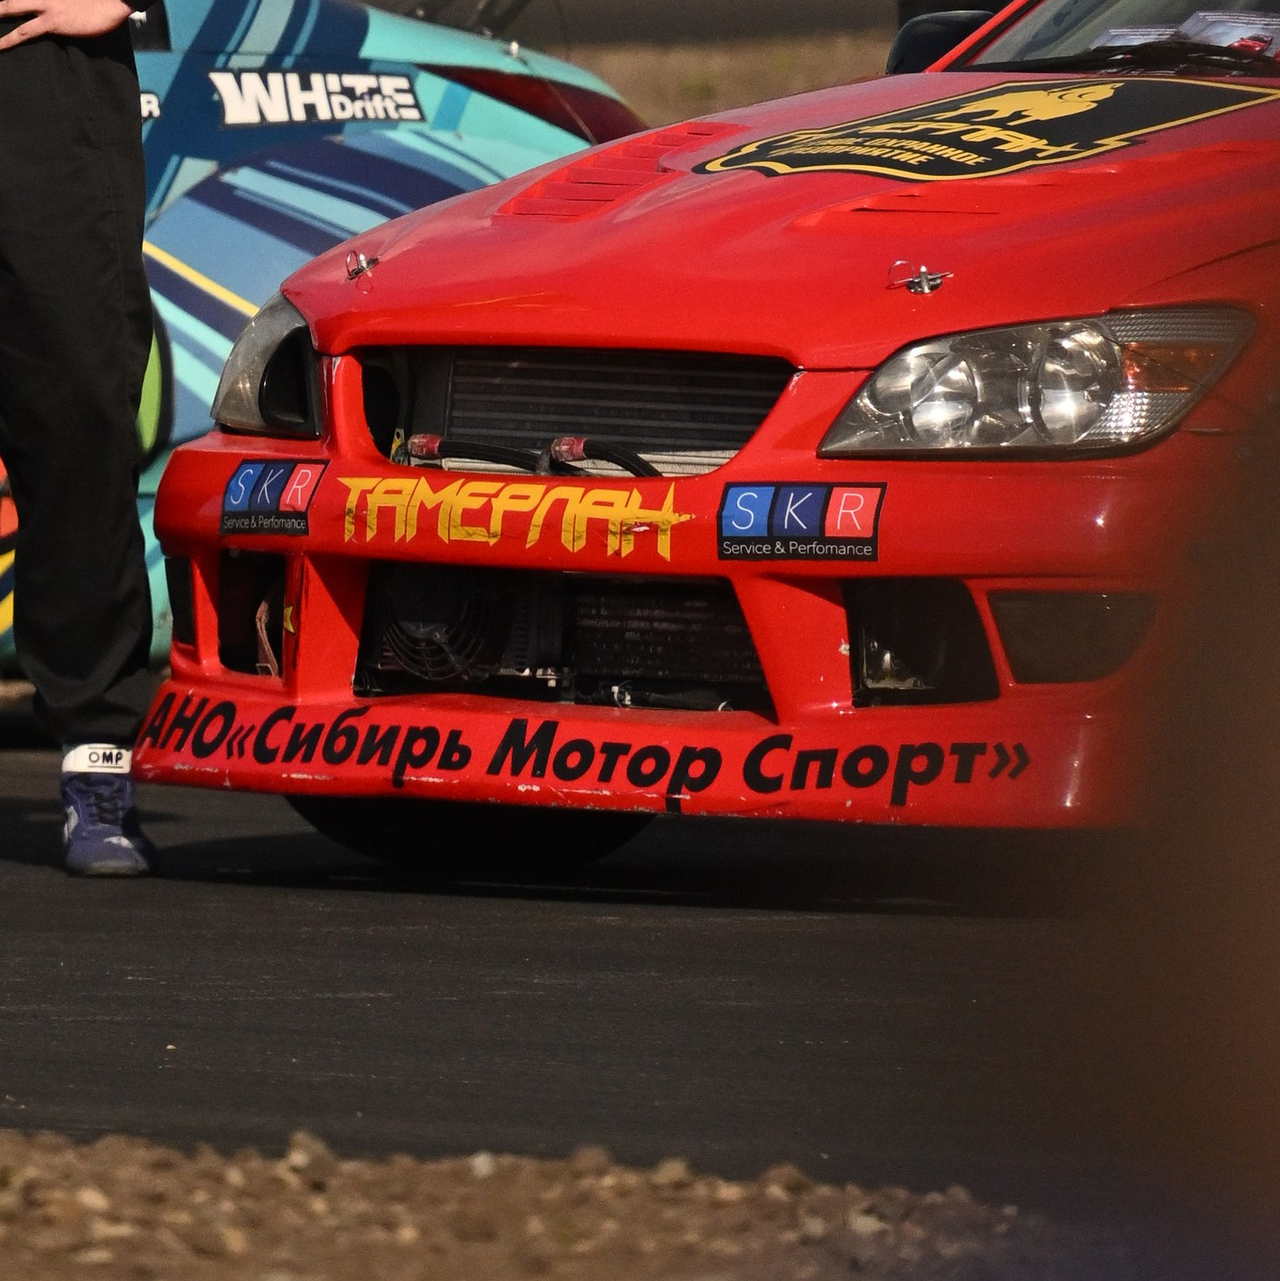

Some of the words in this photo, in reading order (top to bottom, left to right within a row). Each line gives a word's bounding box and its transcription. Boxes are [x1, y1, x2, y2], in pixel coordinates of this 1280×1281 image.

[209, 72, 422, 124] WHITE
[331, 94, 401, 121] Drift
[223, 516, 249, 529] Service
[251, 516, 257, 527] &
[337, 476, 696, 562] ТАМЕРЛАН
[731, 492, 865, 530] SKR
[723, 541, 771, 555] Service
[774, 542, 786, 554] &
[789, 541, 872, 555] Perfomance
[88, 751, 123, 765] OMP
[486, 718, 722, 813] Мотор
[742, 734, 1031, 806] Спорт»
